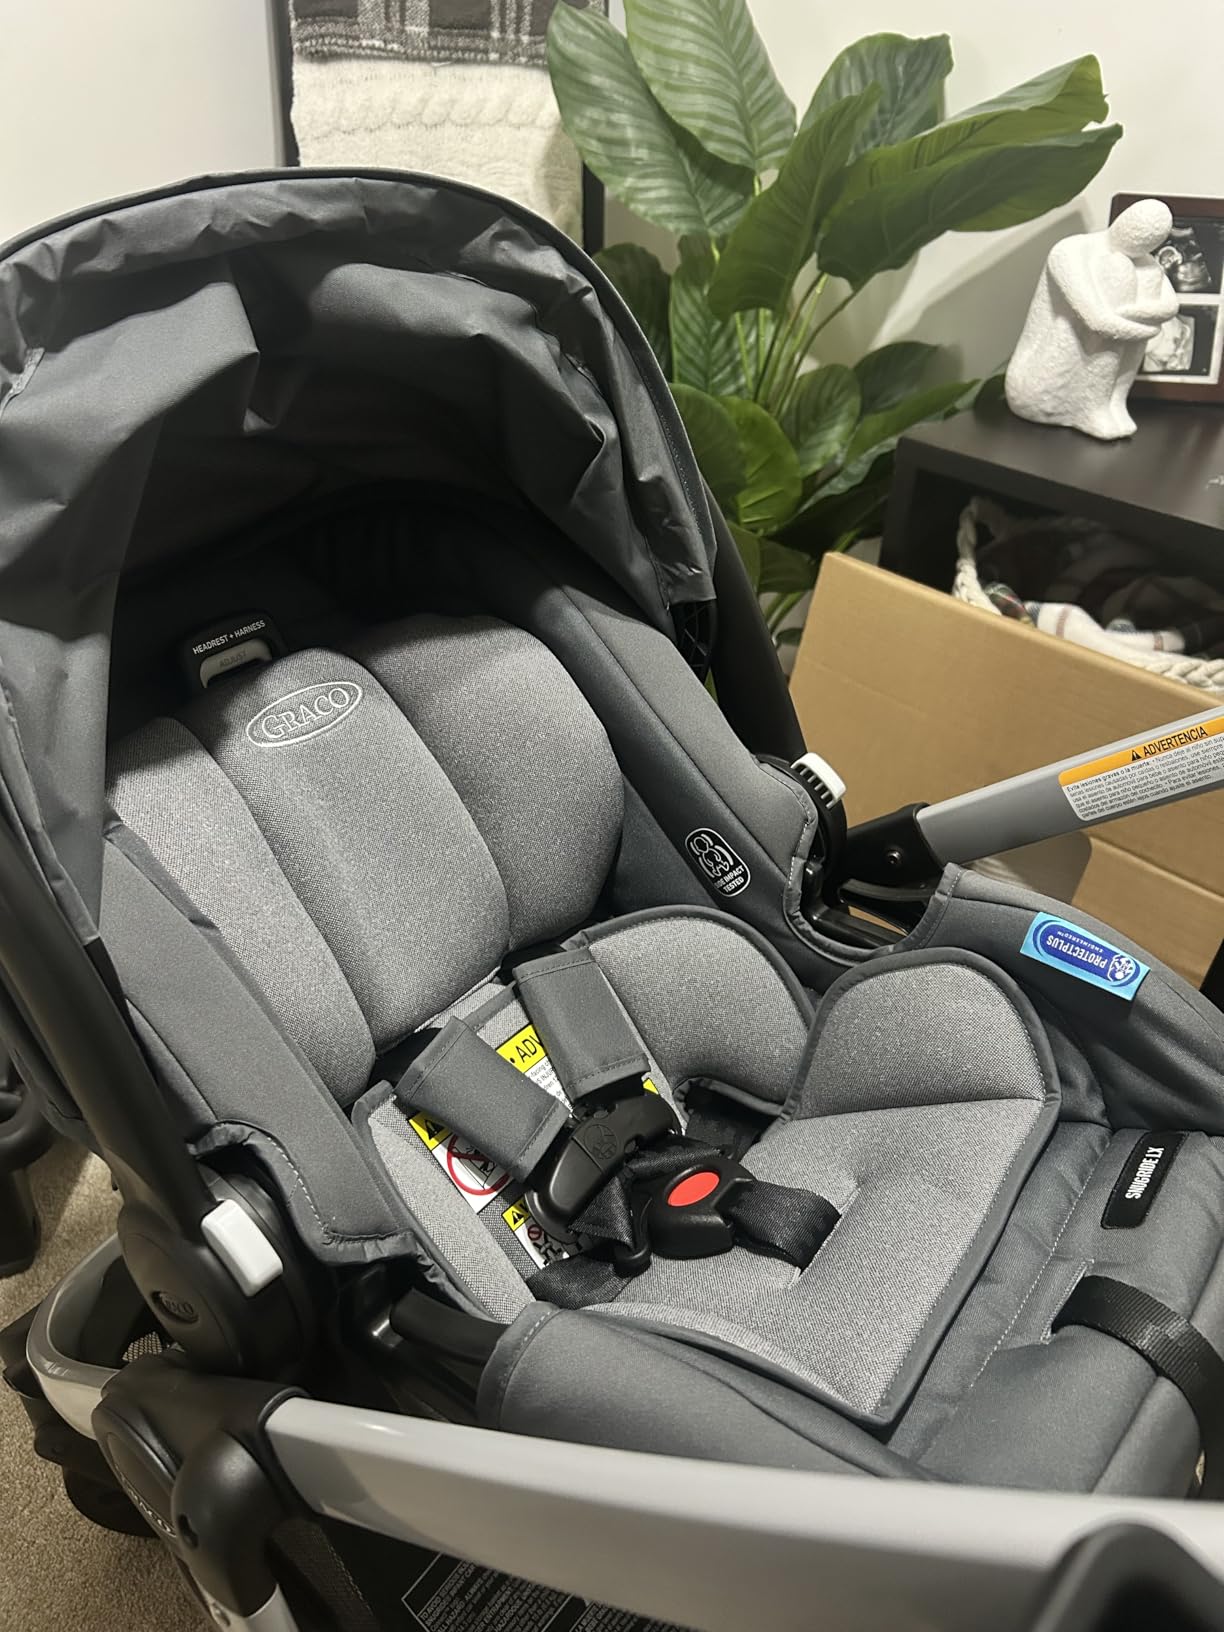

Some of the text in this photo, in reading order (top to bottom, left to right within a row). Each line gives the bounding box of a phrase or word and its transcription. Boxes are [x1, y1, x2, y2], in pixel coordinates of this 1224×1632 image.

[192, 634, 229, 654] HEADREST
[234, 620, 266, 638] HARNESS
[218, 650, 248, 668] ADJUST
[261, 688, 350, 739] GRACO
[1143, 726, 1208, 757] ADVERTENCIA
[723, 865, 745, 882] IMPACT
[723, 876, 744, 892] TESTED
[1046, 935, 1108, 969] PROTECTPLUS
[1125, 1147, 1164, 1199] SNUGRIDE LX
